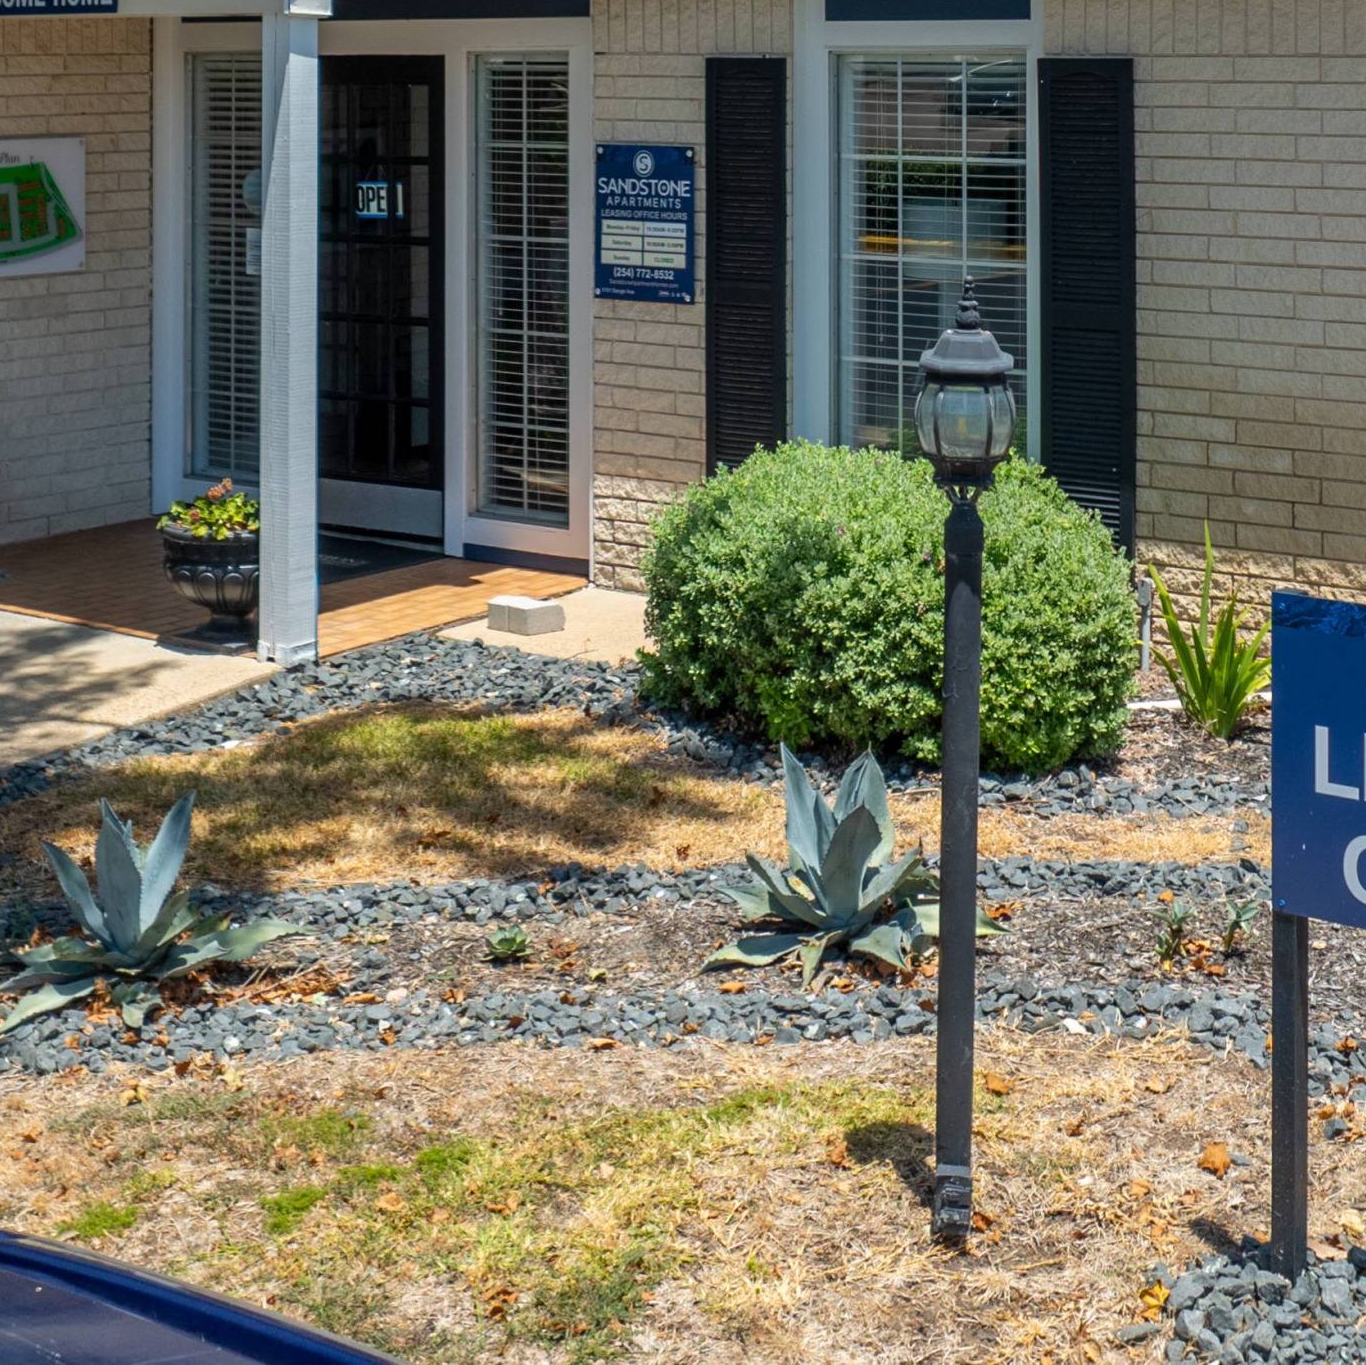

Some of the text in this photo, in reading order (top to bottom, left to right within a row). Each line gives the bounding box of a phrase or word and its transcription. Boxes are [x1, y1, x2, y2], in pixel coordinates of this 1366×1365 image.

[598, 177, 691, 197] SANDSTONE
[356, 185, 392, 213] OPE
[606, 196, 681, 209] APARTMENTS
[601, 209, 688, 221] LEASING OFFICE HOURS
[613, 267, 674, 280] (254) 772-8532
